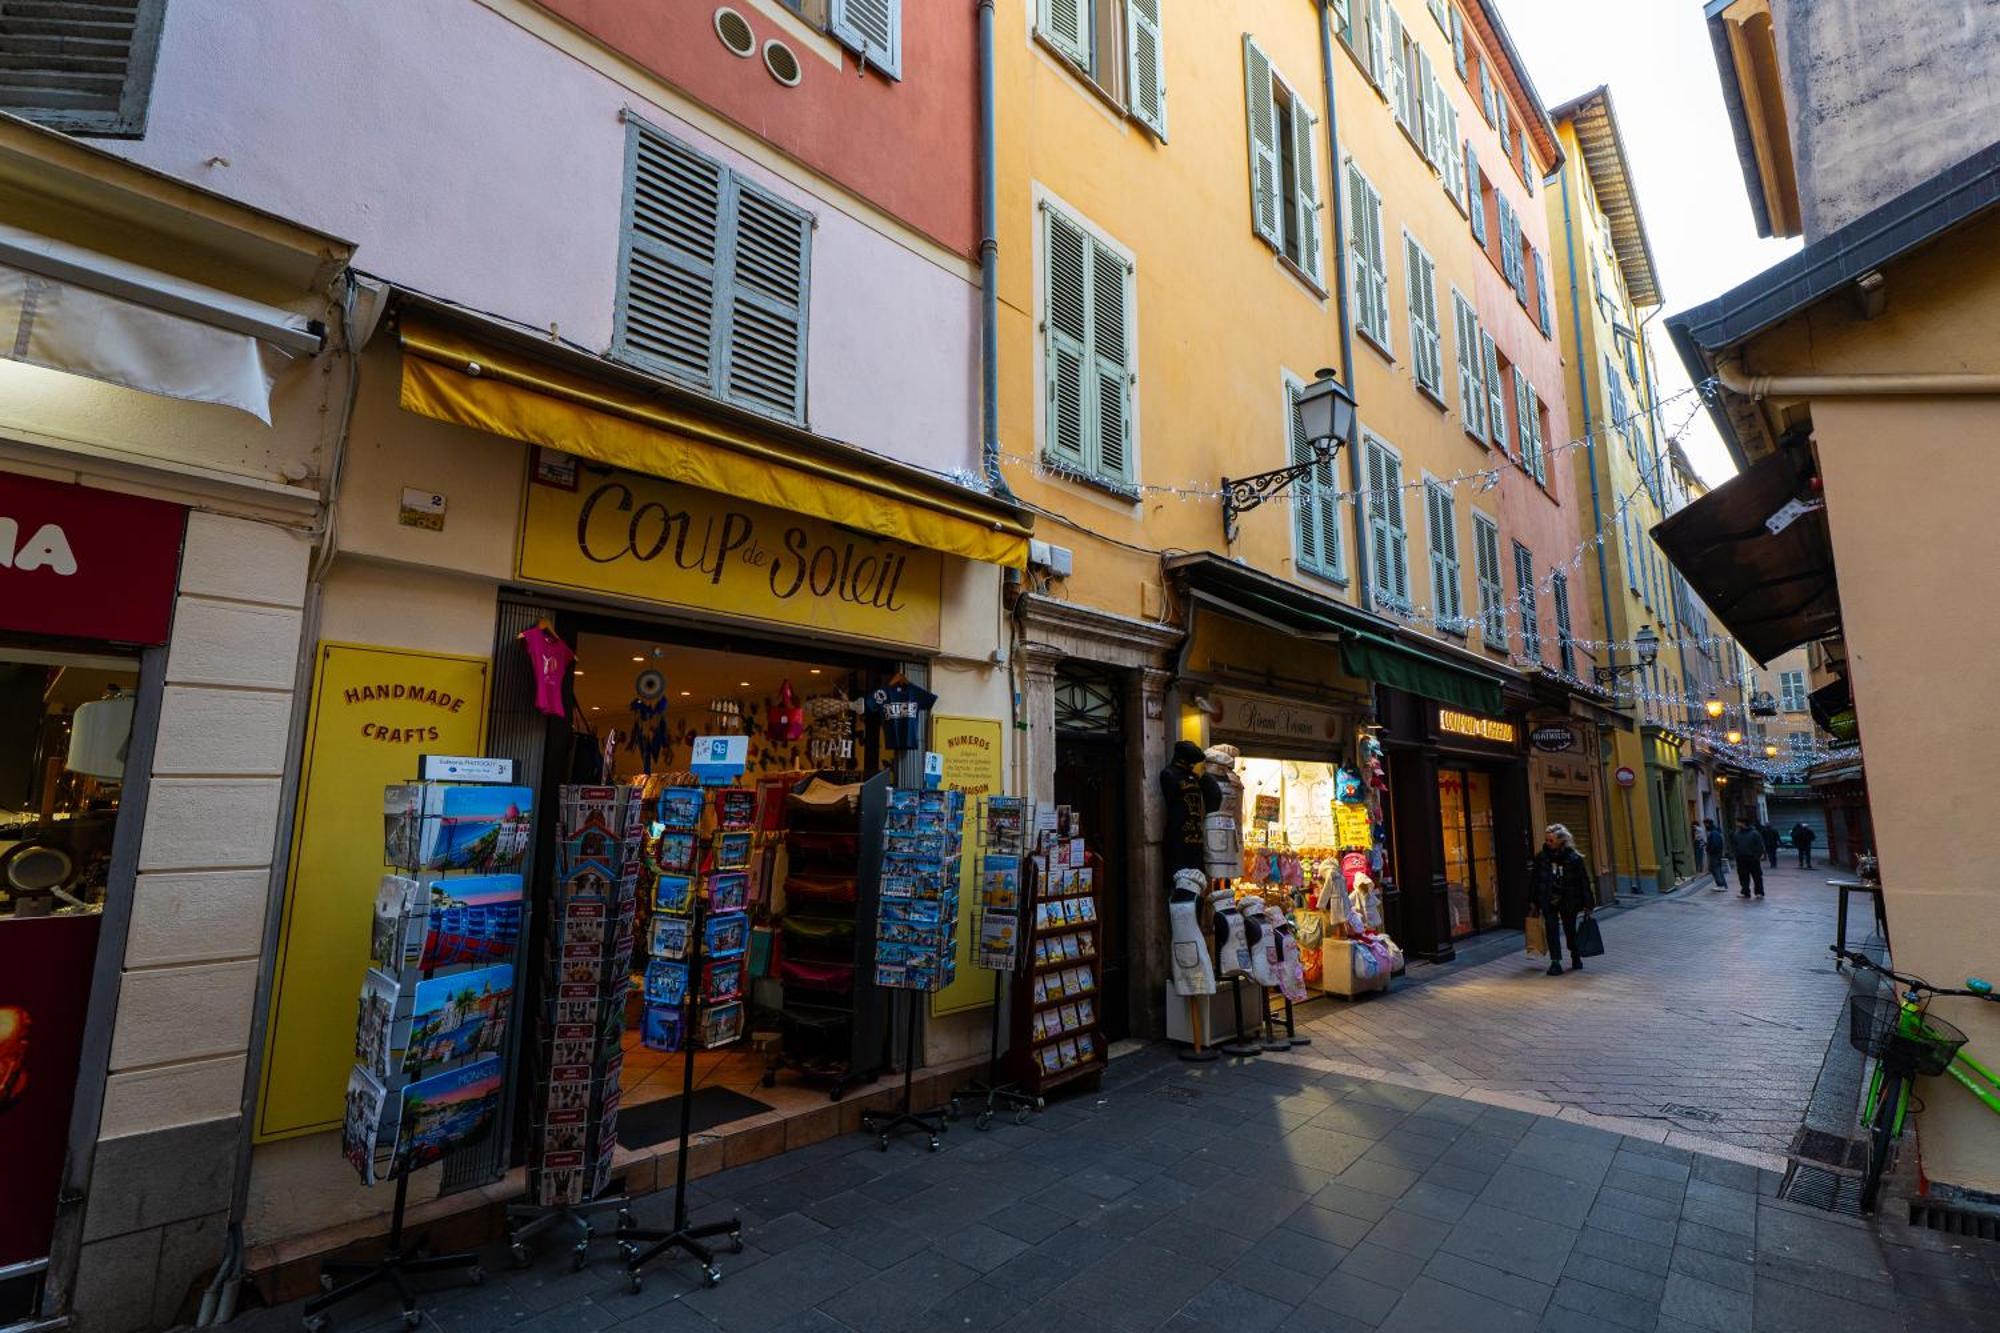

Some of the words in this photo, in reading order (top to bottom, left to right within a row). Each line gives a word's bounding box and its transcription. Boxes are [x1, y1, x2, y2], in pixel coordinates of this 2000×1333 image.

[432, 495, 442, 506] 2
[742, 540, 767, 568] de
[769, 527, 905, 612] Soleil
[344, 684, 465, 713] HANDMADE
[360, 723, 439, 744] CRAFTS
